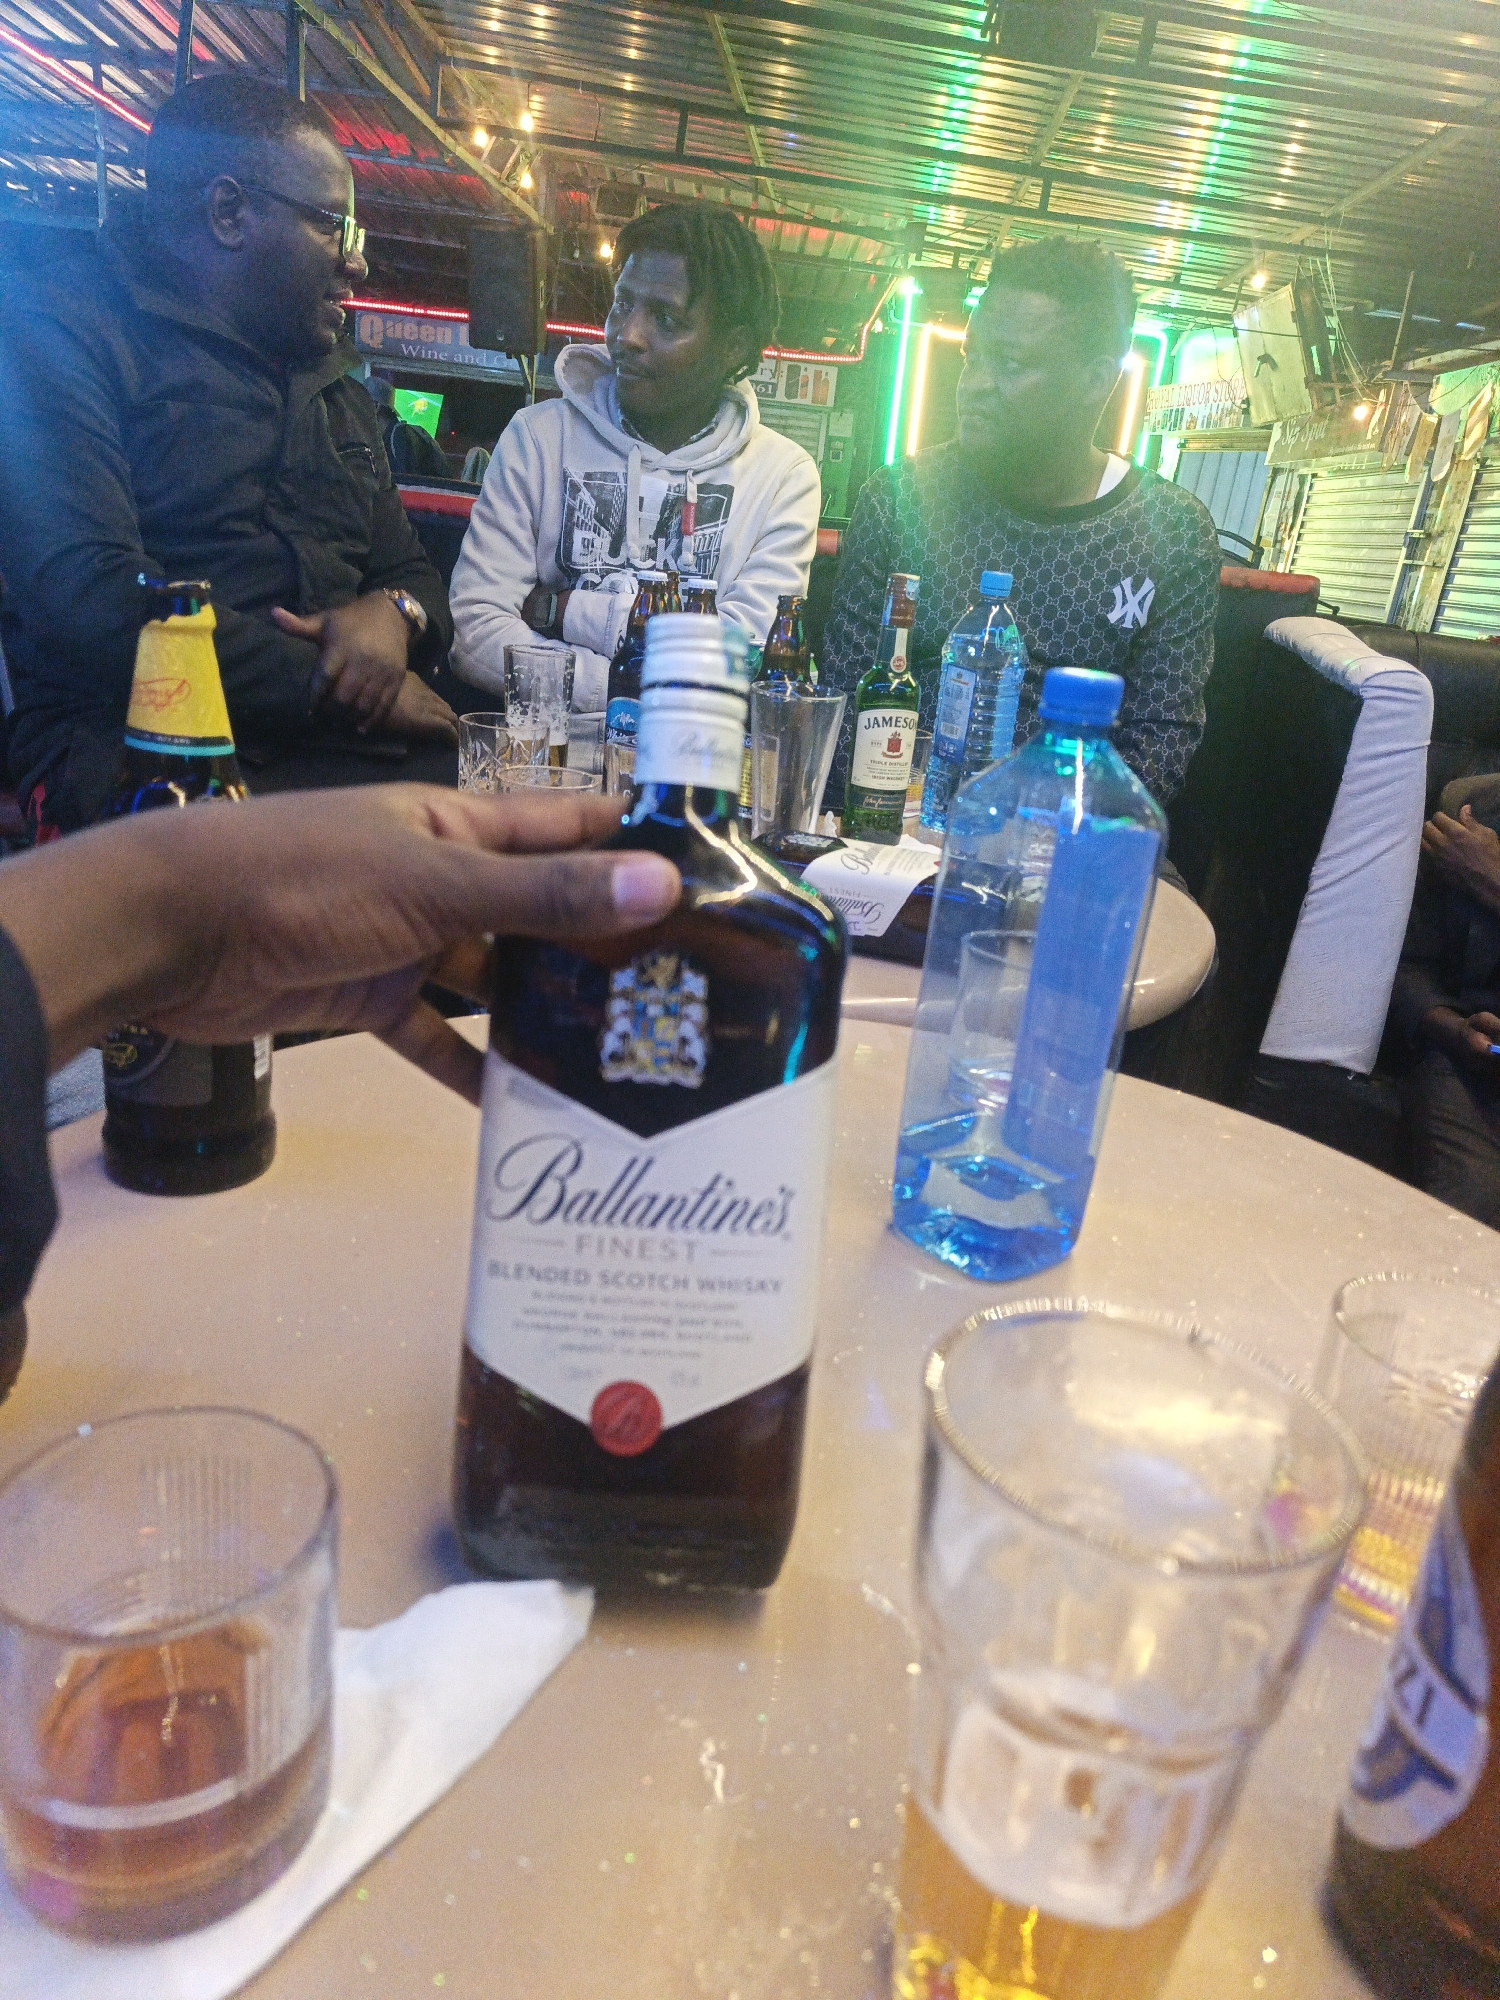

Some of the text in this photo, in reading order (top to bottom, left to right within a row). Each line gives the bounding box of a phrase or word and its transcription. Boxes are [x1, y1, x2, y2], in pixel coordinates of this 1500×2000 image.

[359, 314, 451, 349] Queen
[401, 343, 448, 361] Wine
[454, 353, 486, 365] and
[1177, 382, 1212, 407] LIQUOR
[1108, 576, 1156, 629] NY
[485, 1132, 796, 1236] Ballantine's
[575, 1233, 698, 1262] FINEST
[487, 1259, 593, 1286] BLENDED
[600, 1268, 690, 1291] SCOTCH
